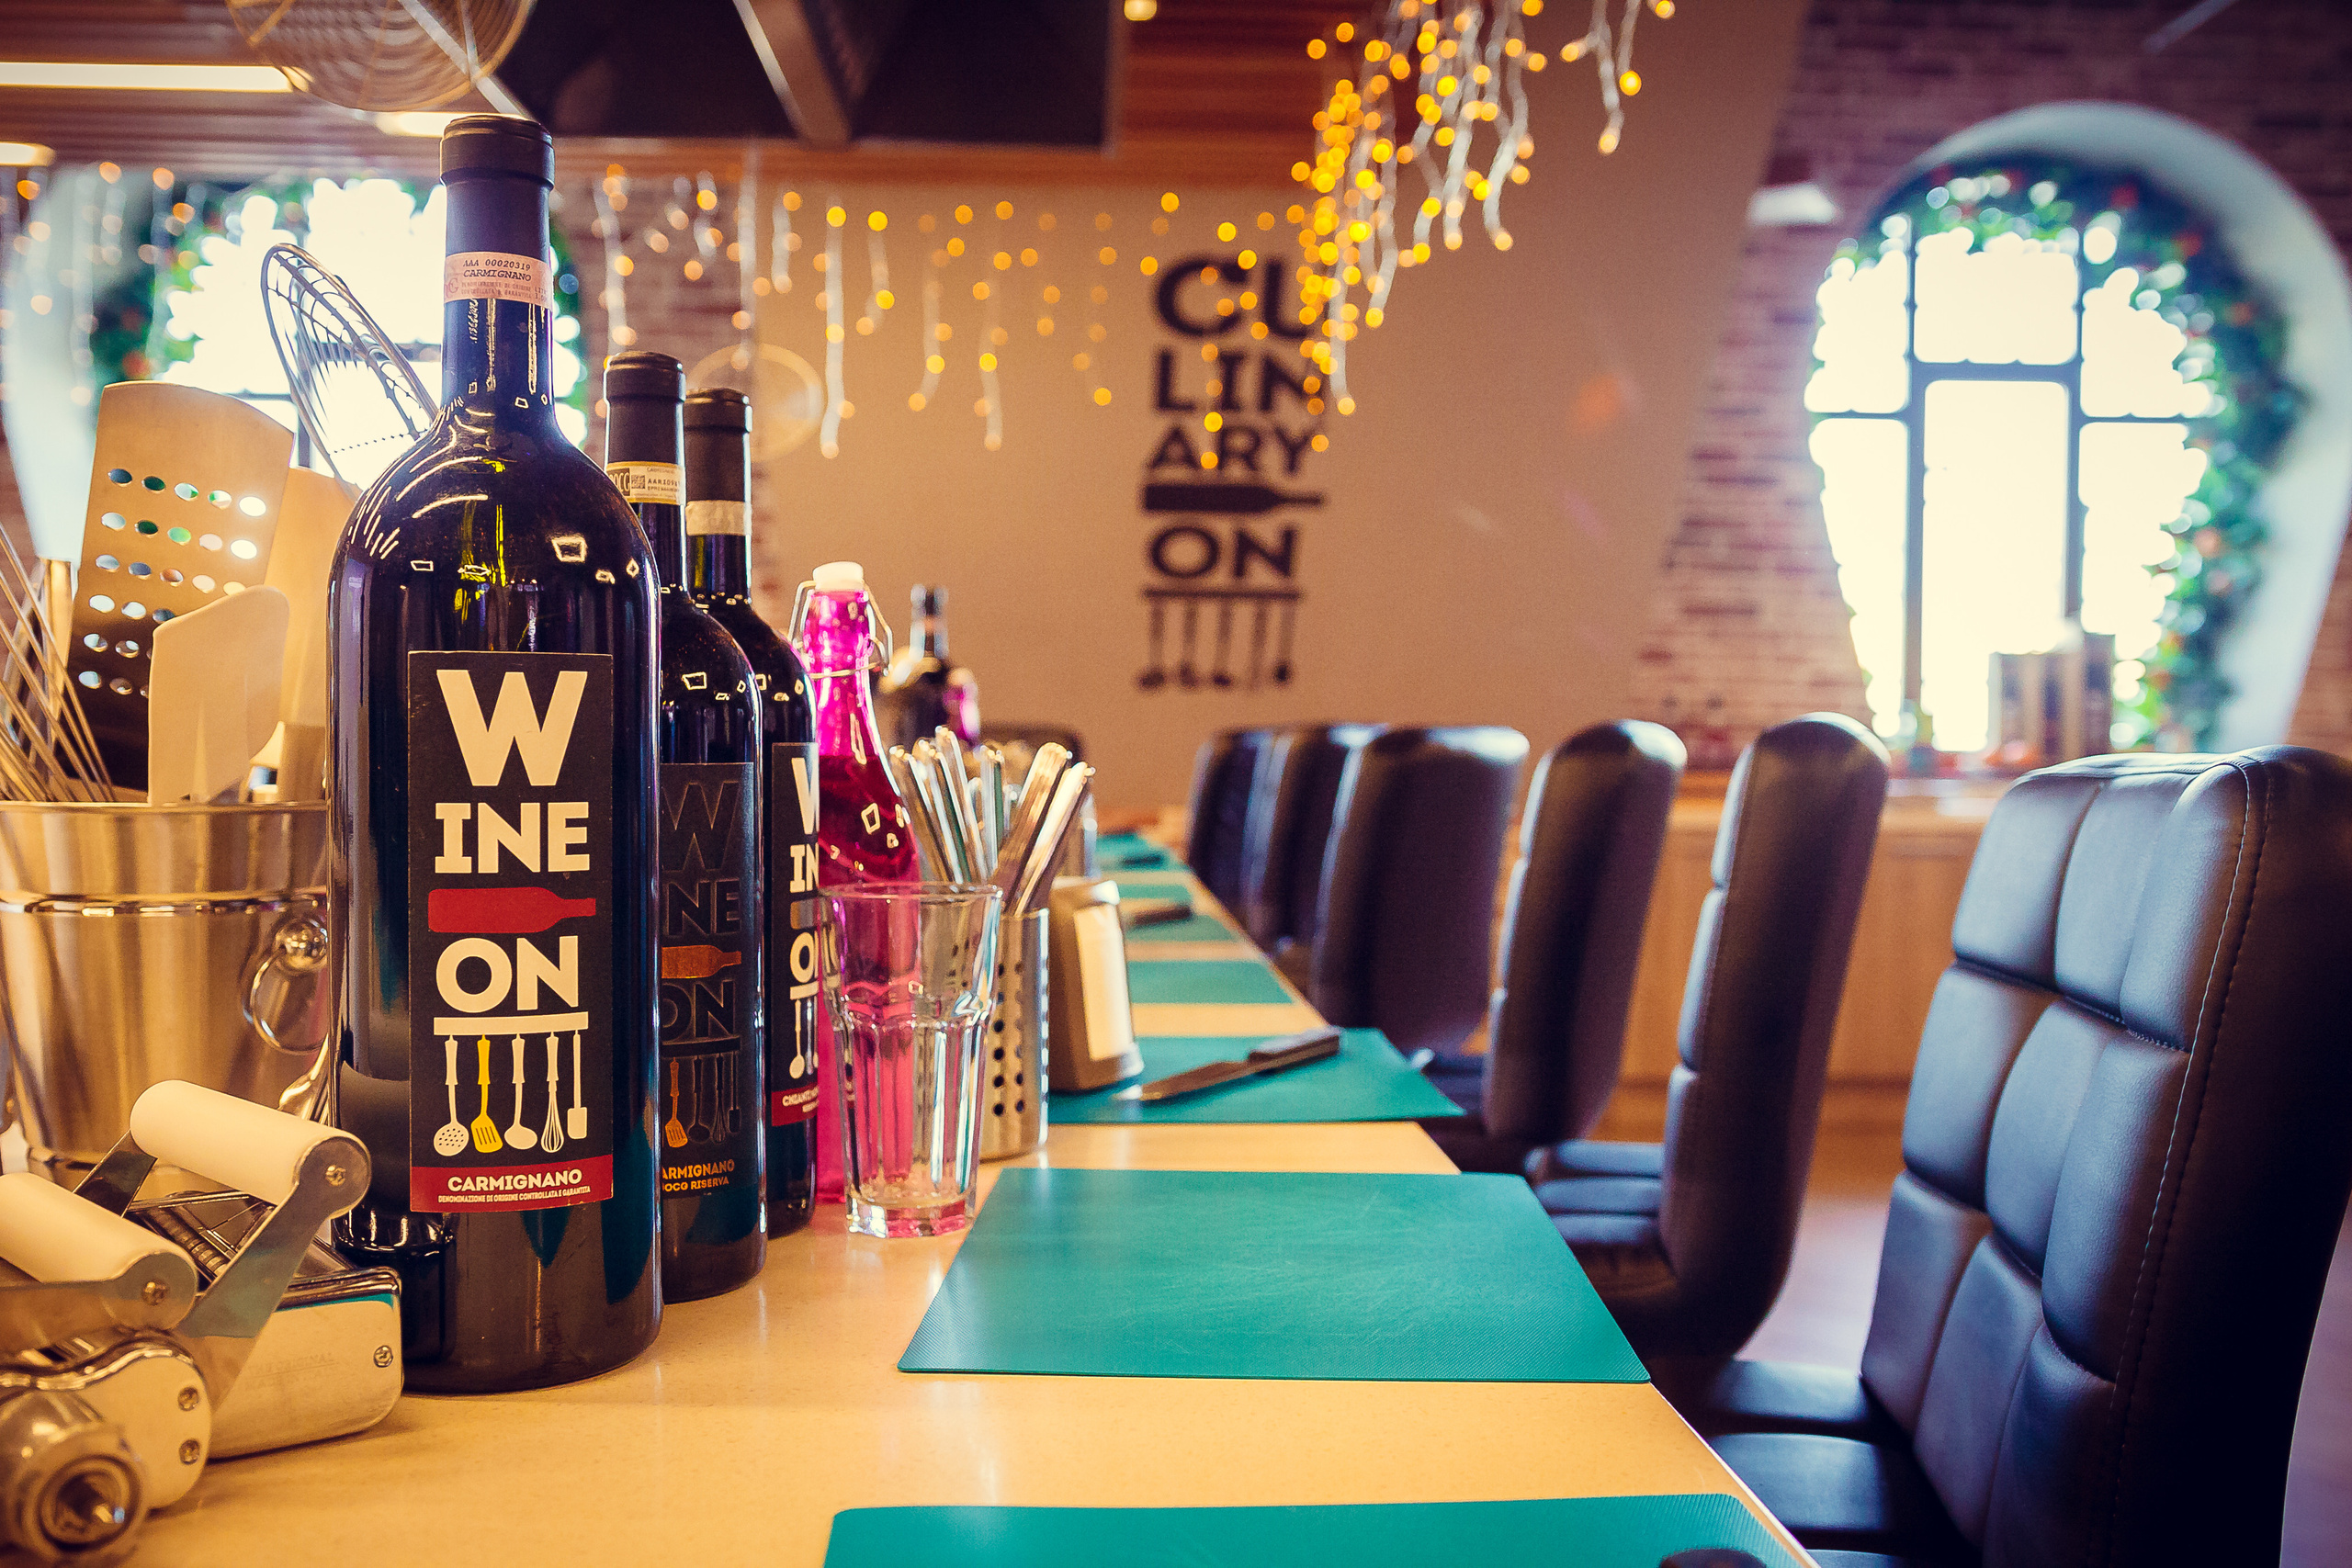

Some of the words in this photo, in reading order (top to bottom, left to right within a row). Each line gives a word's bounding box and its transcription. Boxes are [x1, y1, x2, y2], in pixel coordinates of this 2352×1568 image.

[463, 269, 531, 281] CARMIGNANO
[485, 259, 530, 271] 00020319
[1155, 256, 1331, 343] CU
[1156, 349, 1329, 414] LIN
[1150, 423, 1321, 476] ARY
[1150, 525, 1298, 581] ON
[436, 670, 588, 786] W
[435, 802, 590, 874] INE
[790, 841, 820, 893] IN
[662, 877, 741, 938] NE
[436, 935, 579, 1013] ON
[447, 1168, 582, 1191] CARMIGNANO
[662, 1158, 735, 1180] ARMIGNANO
[690, 1176, 729, 1190] RISERVA
[493, 1194, 519, 1202] ORIGINE
[519, 1191, 559, 1201] CONTROLLATA
